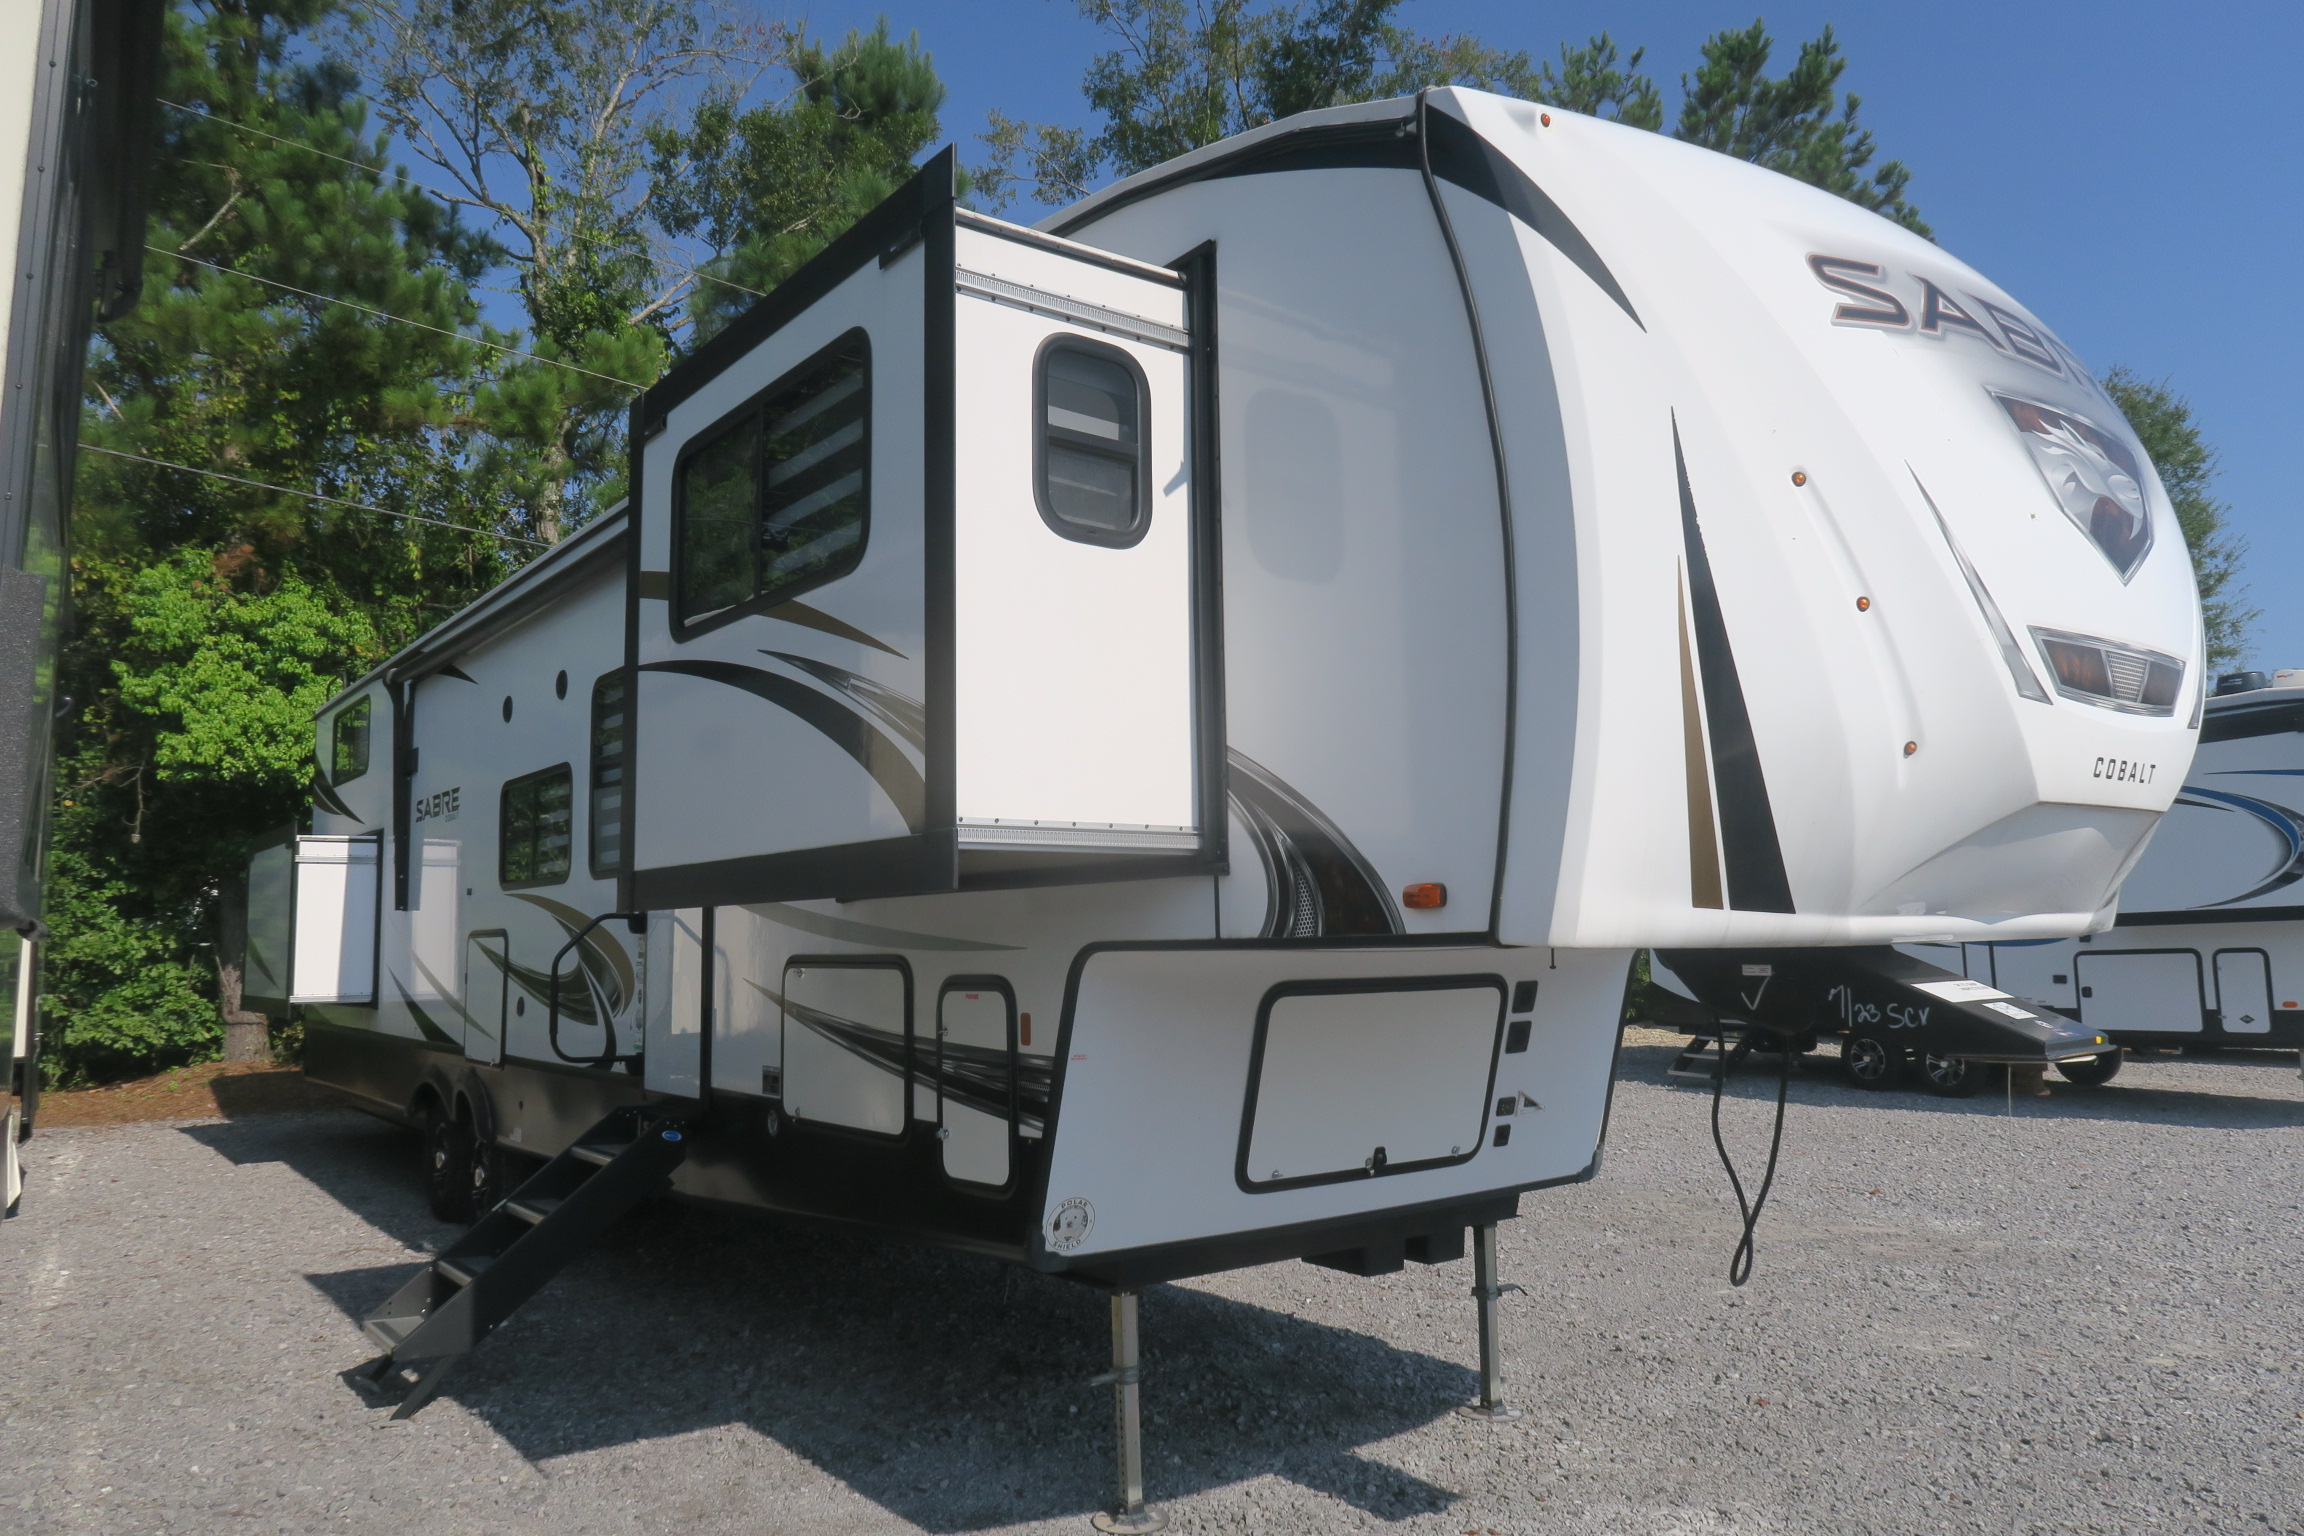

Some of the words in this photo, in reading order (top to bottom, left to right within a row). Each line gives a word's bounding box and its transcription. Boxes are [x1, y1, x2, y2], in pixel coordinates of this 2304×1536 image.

[2093, 756, 2156, 785] COBALT
[415, 786, 461, 823] SABRE
[1060, 1199, 1088, 1209] POLAR
[1052, 1238, 1082, 1250] SHIELD
